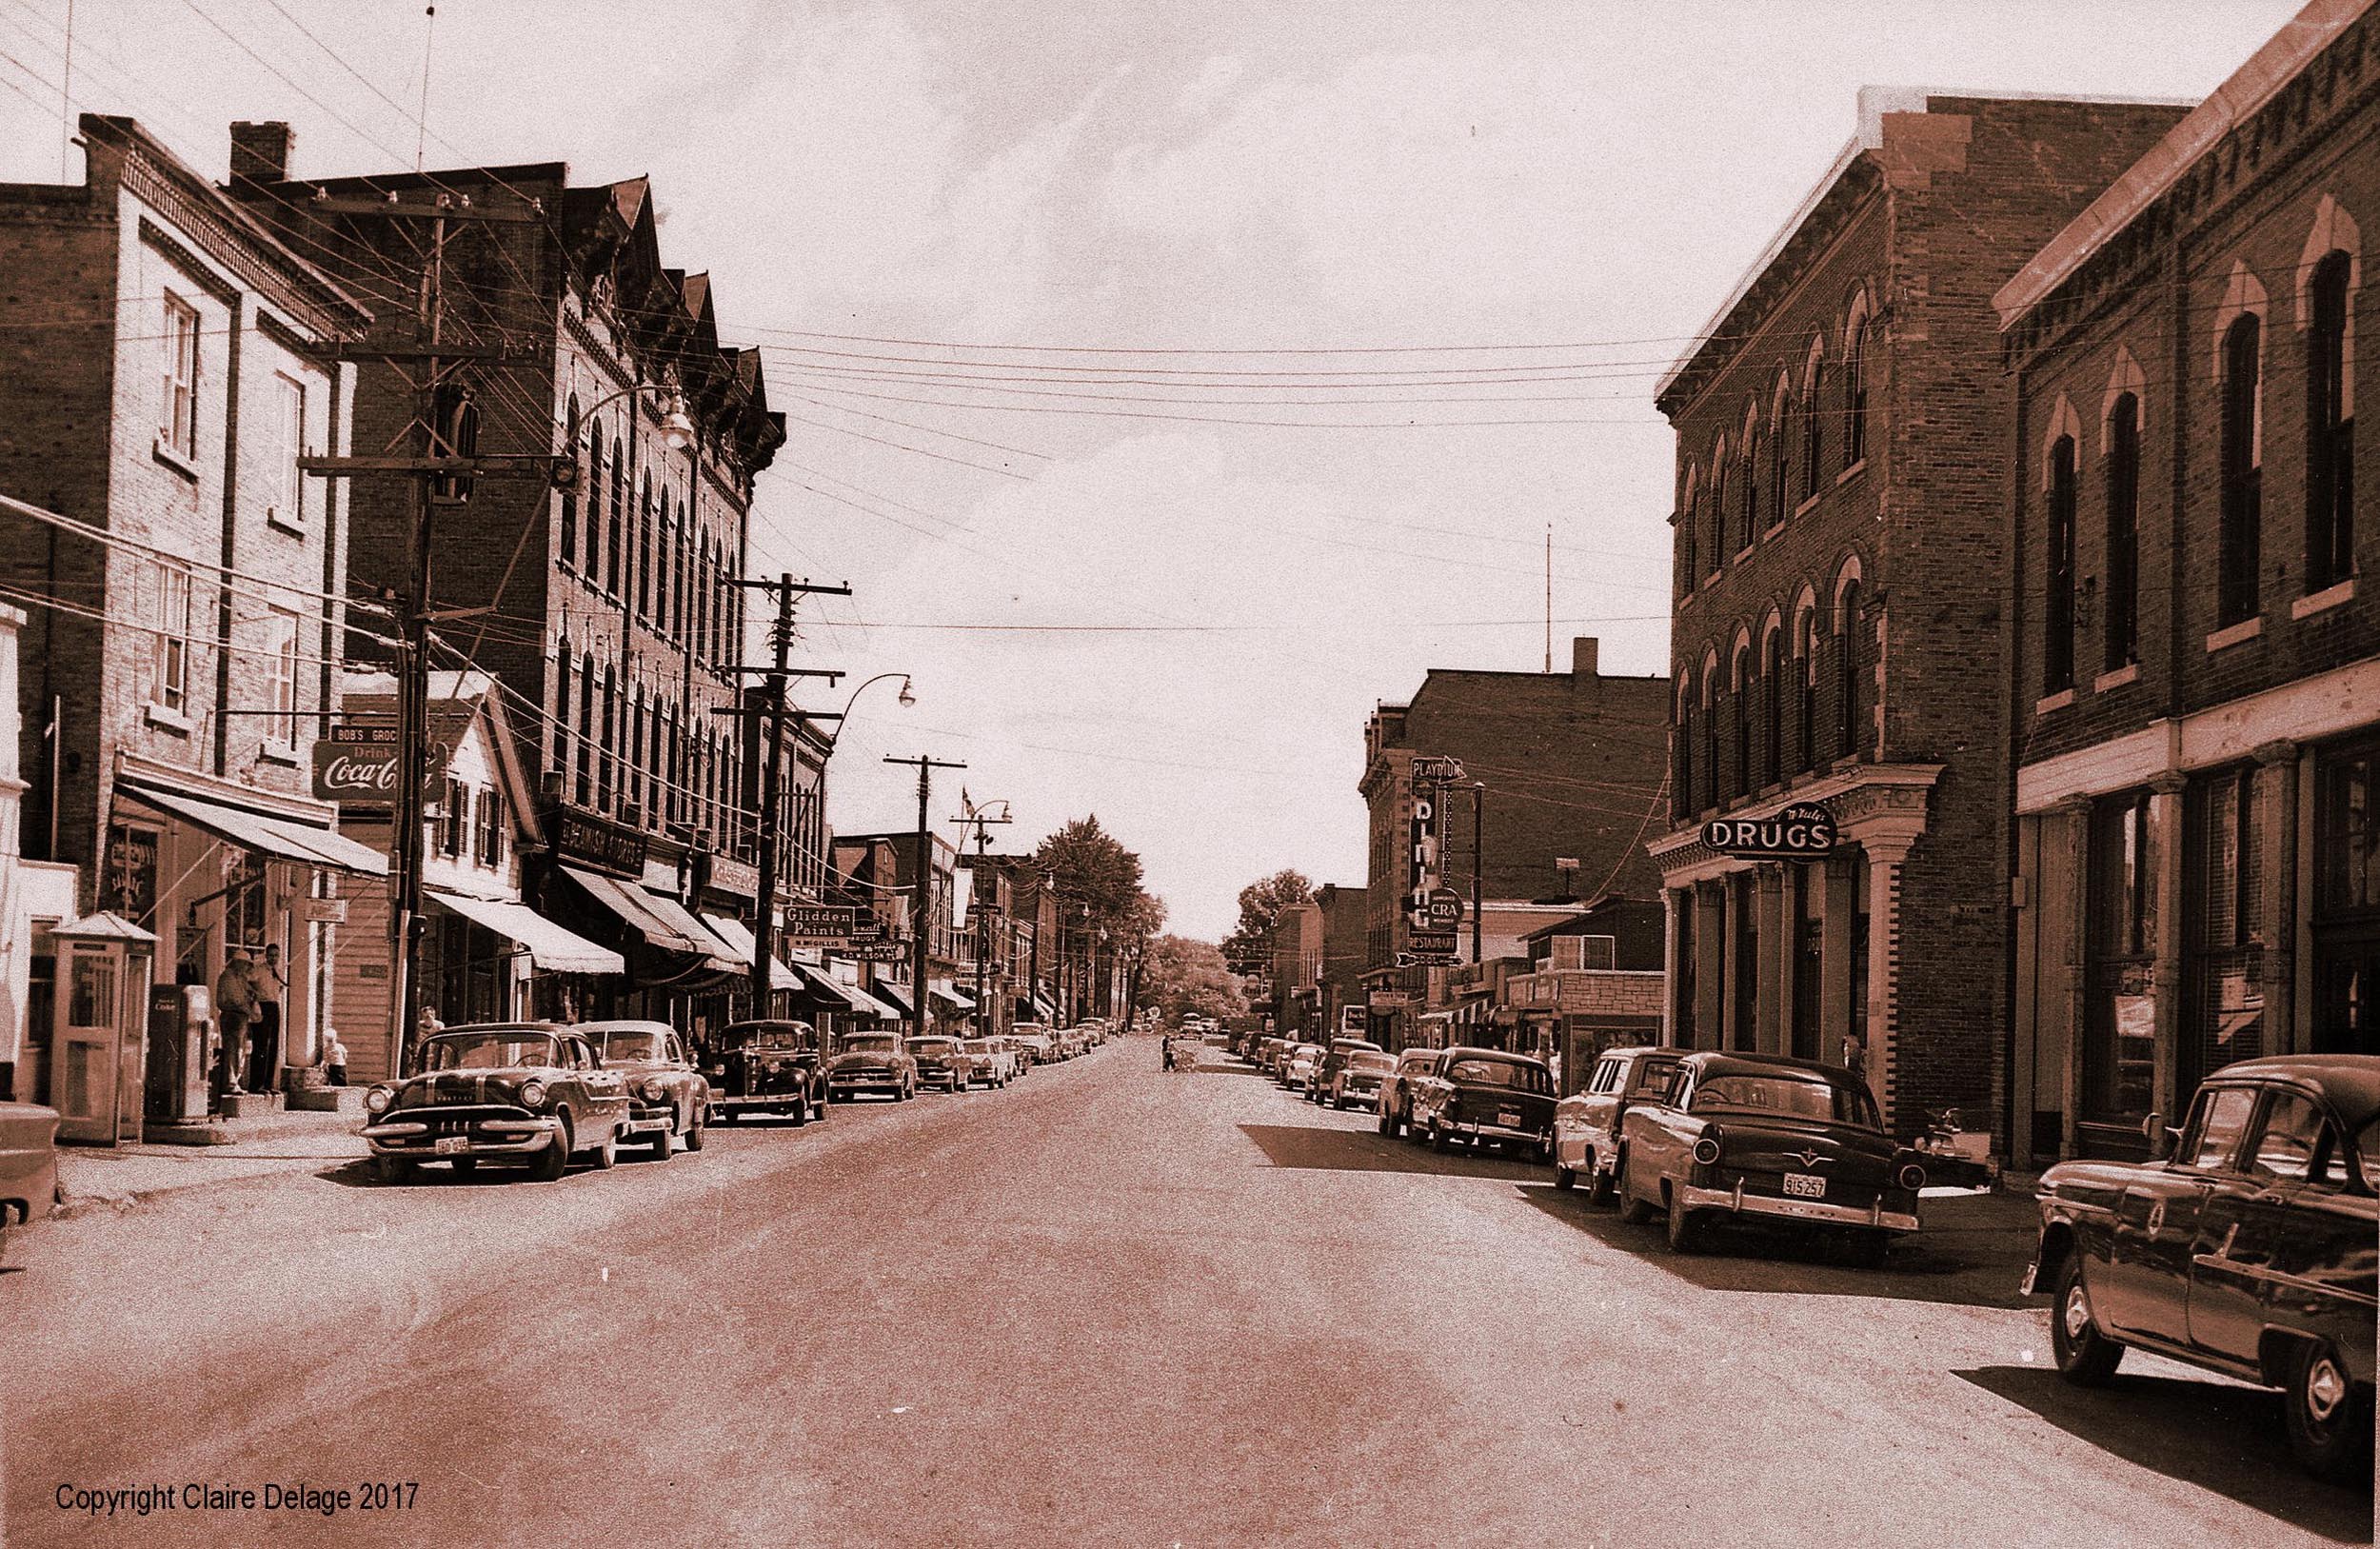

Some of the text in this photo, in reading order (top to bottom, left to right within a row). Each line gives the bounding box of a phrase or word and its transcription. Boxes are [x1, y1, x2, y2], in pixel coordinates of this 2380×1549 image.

[338, 729, 364, 741] BOB'S
[354, 746, 391, 758] Drink
[1712, 822, 1832, 849] DRUGS
[786, 907, 851, 922] Glidden
[1431, 904, 1458, 917] CRA
[794, 922, 844, 936] Paints
[854, 923, 881, 932] exall
[1409, 937, 1456, 949] RESTAURANT
